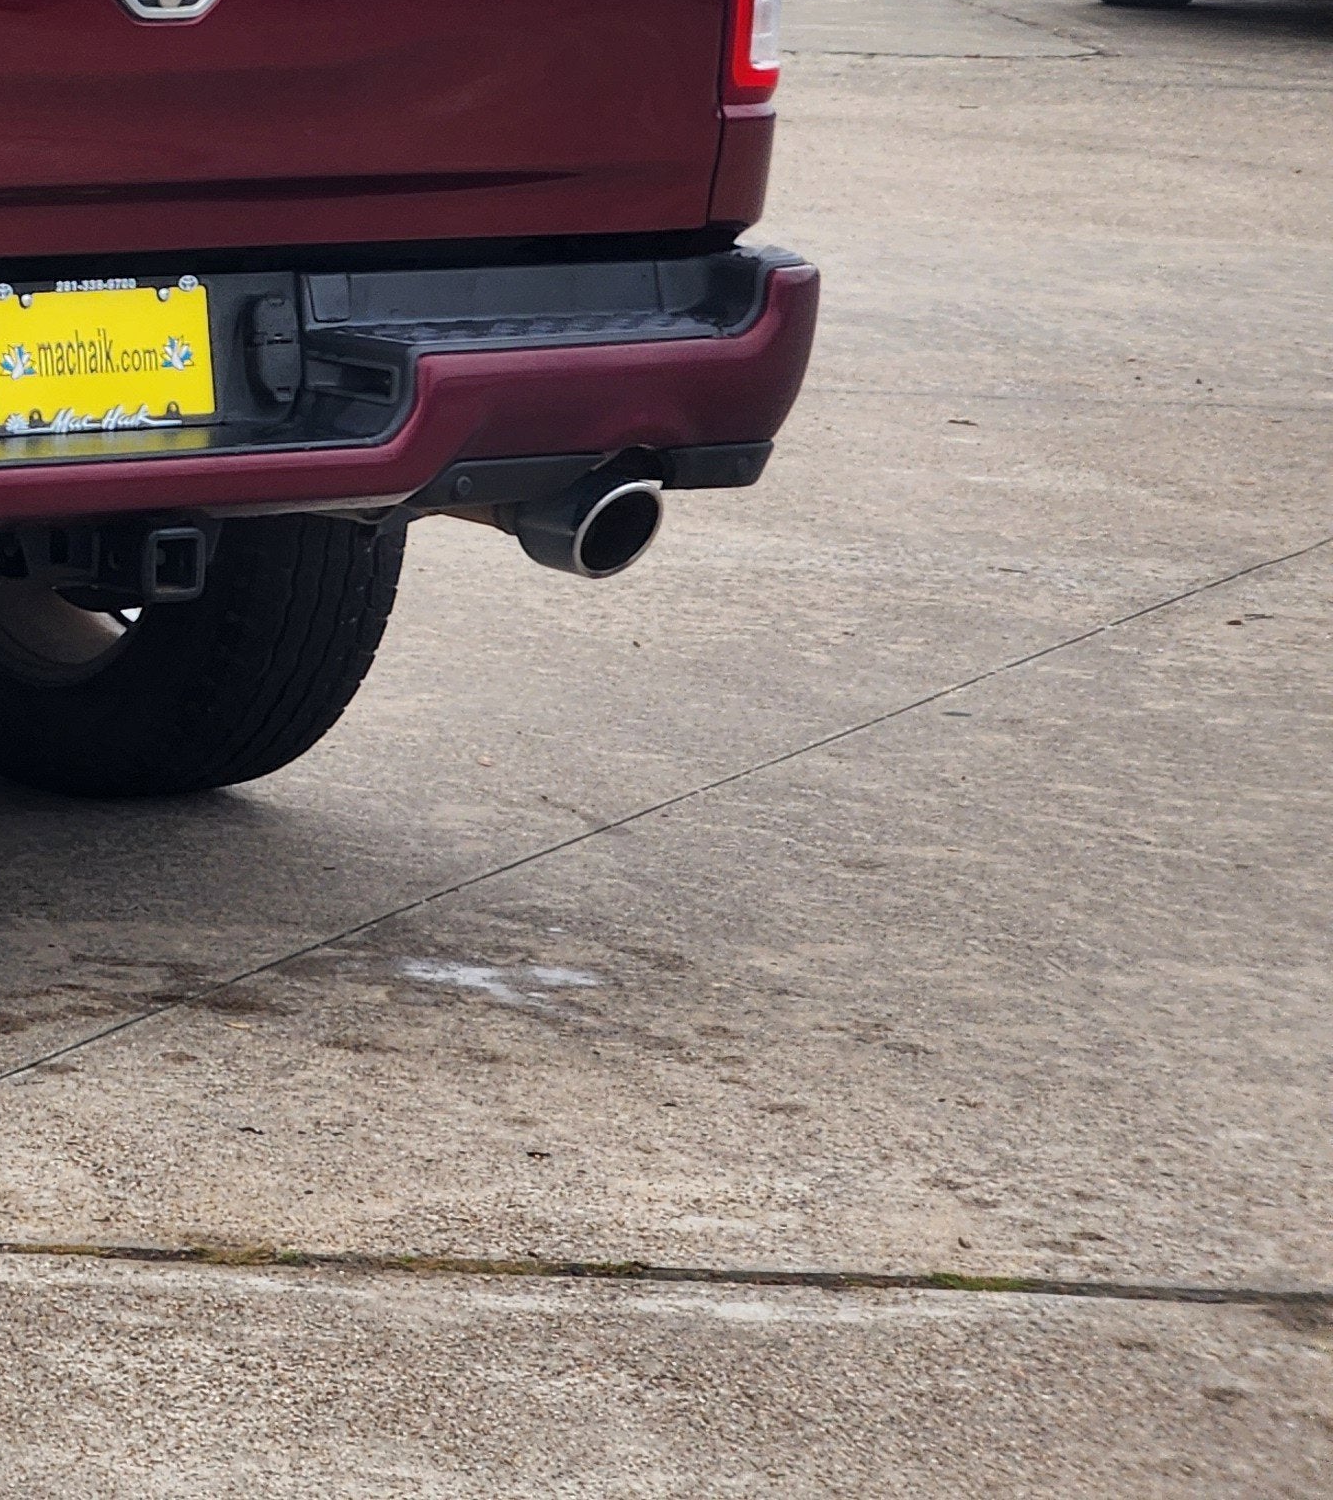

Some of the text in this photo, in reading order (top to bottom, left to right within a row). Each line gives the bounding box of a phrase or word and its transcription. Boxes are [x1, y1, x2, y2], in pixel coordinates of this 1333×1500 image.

[37, 328, 159, 378] machaik.com
[46, 404, 175, 434] Mac Haik
